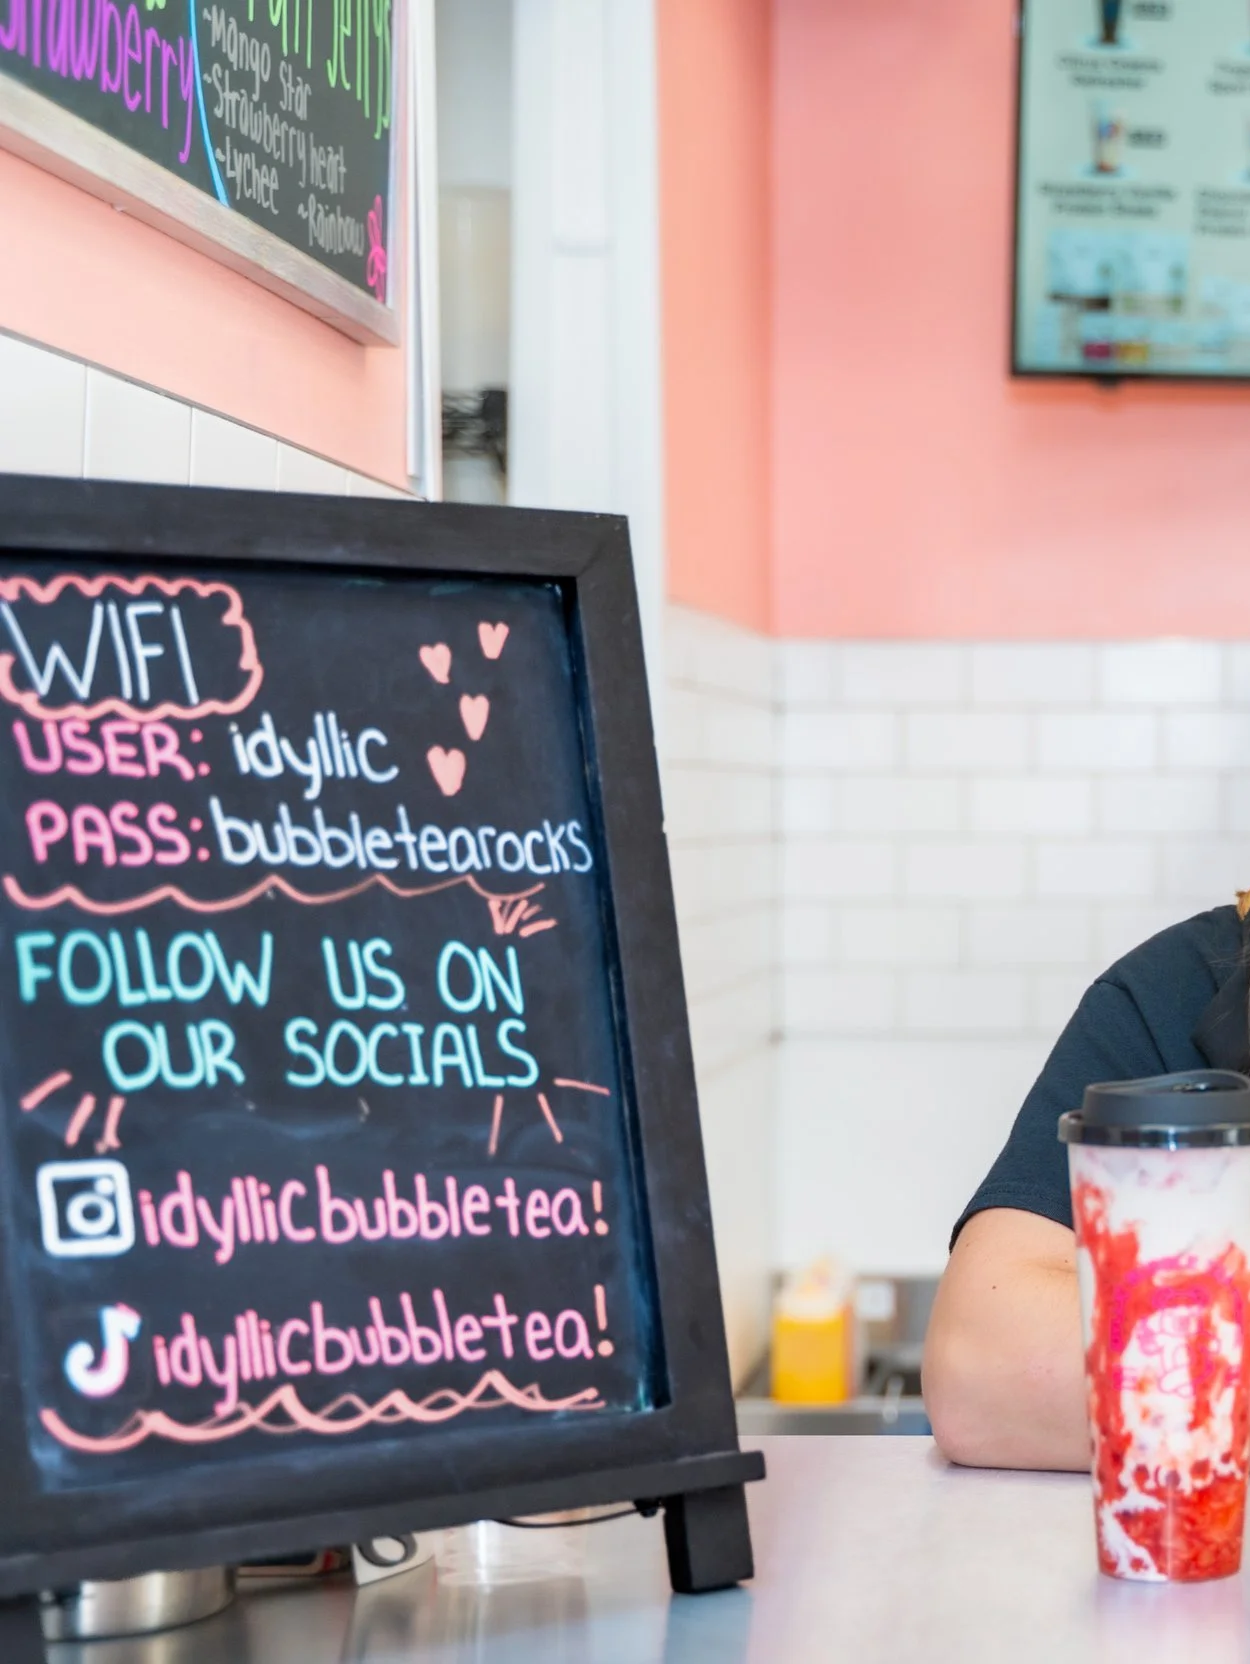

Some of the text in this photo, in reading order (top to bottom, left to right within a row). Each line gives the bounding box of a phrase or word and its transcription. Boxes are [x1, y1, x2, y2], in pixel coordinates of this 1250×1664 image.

[211, 4, 271, 102] Mango
[279, 60, 312, 121] Star
[211, 63, 347, 194] Strawberry heart
[226, 135, 279, 215] Lychee
[308, 193, 364, 257] Rainbow
[2, 601, 199, 704] WIFI
[13, 712, 400, 800] USER: idyllic
[25, 797, 594, 875] PASS: bubbletearocks
[15, 929, 525, 1016] FOLLOW US ON
[103, 1017, 539, 1090] OUR SOCIALS
